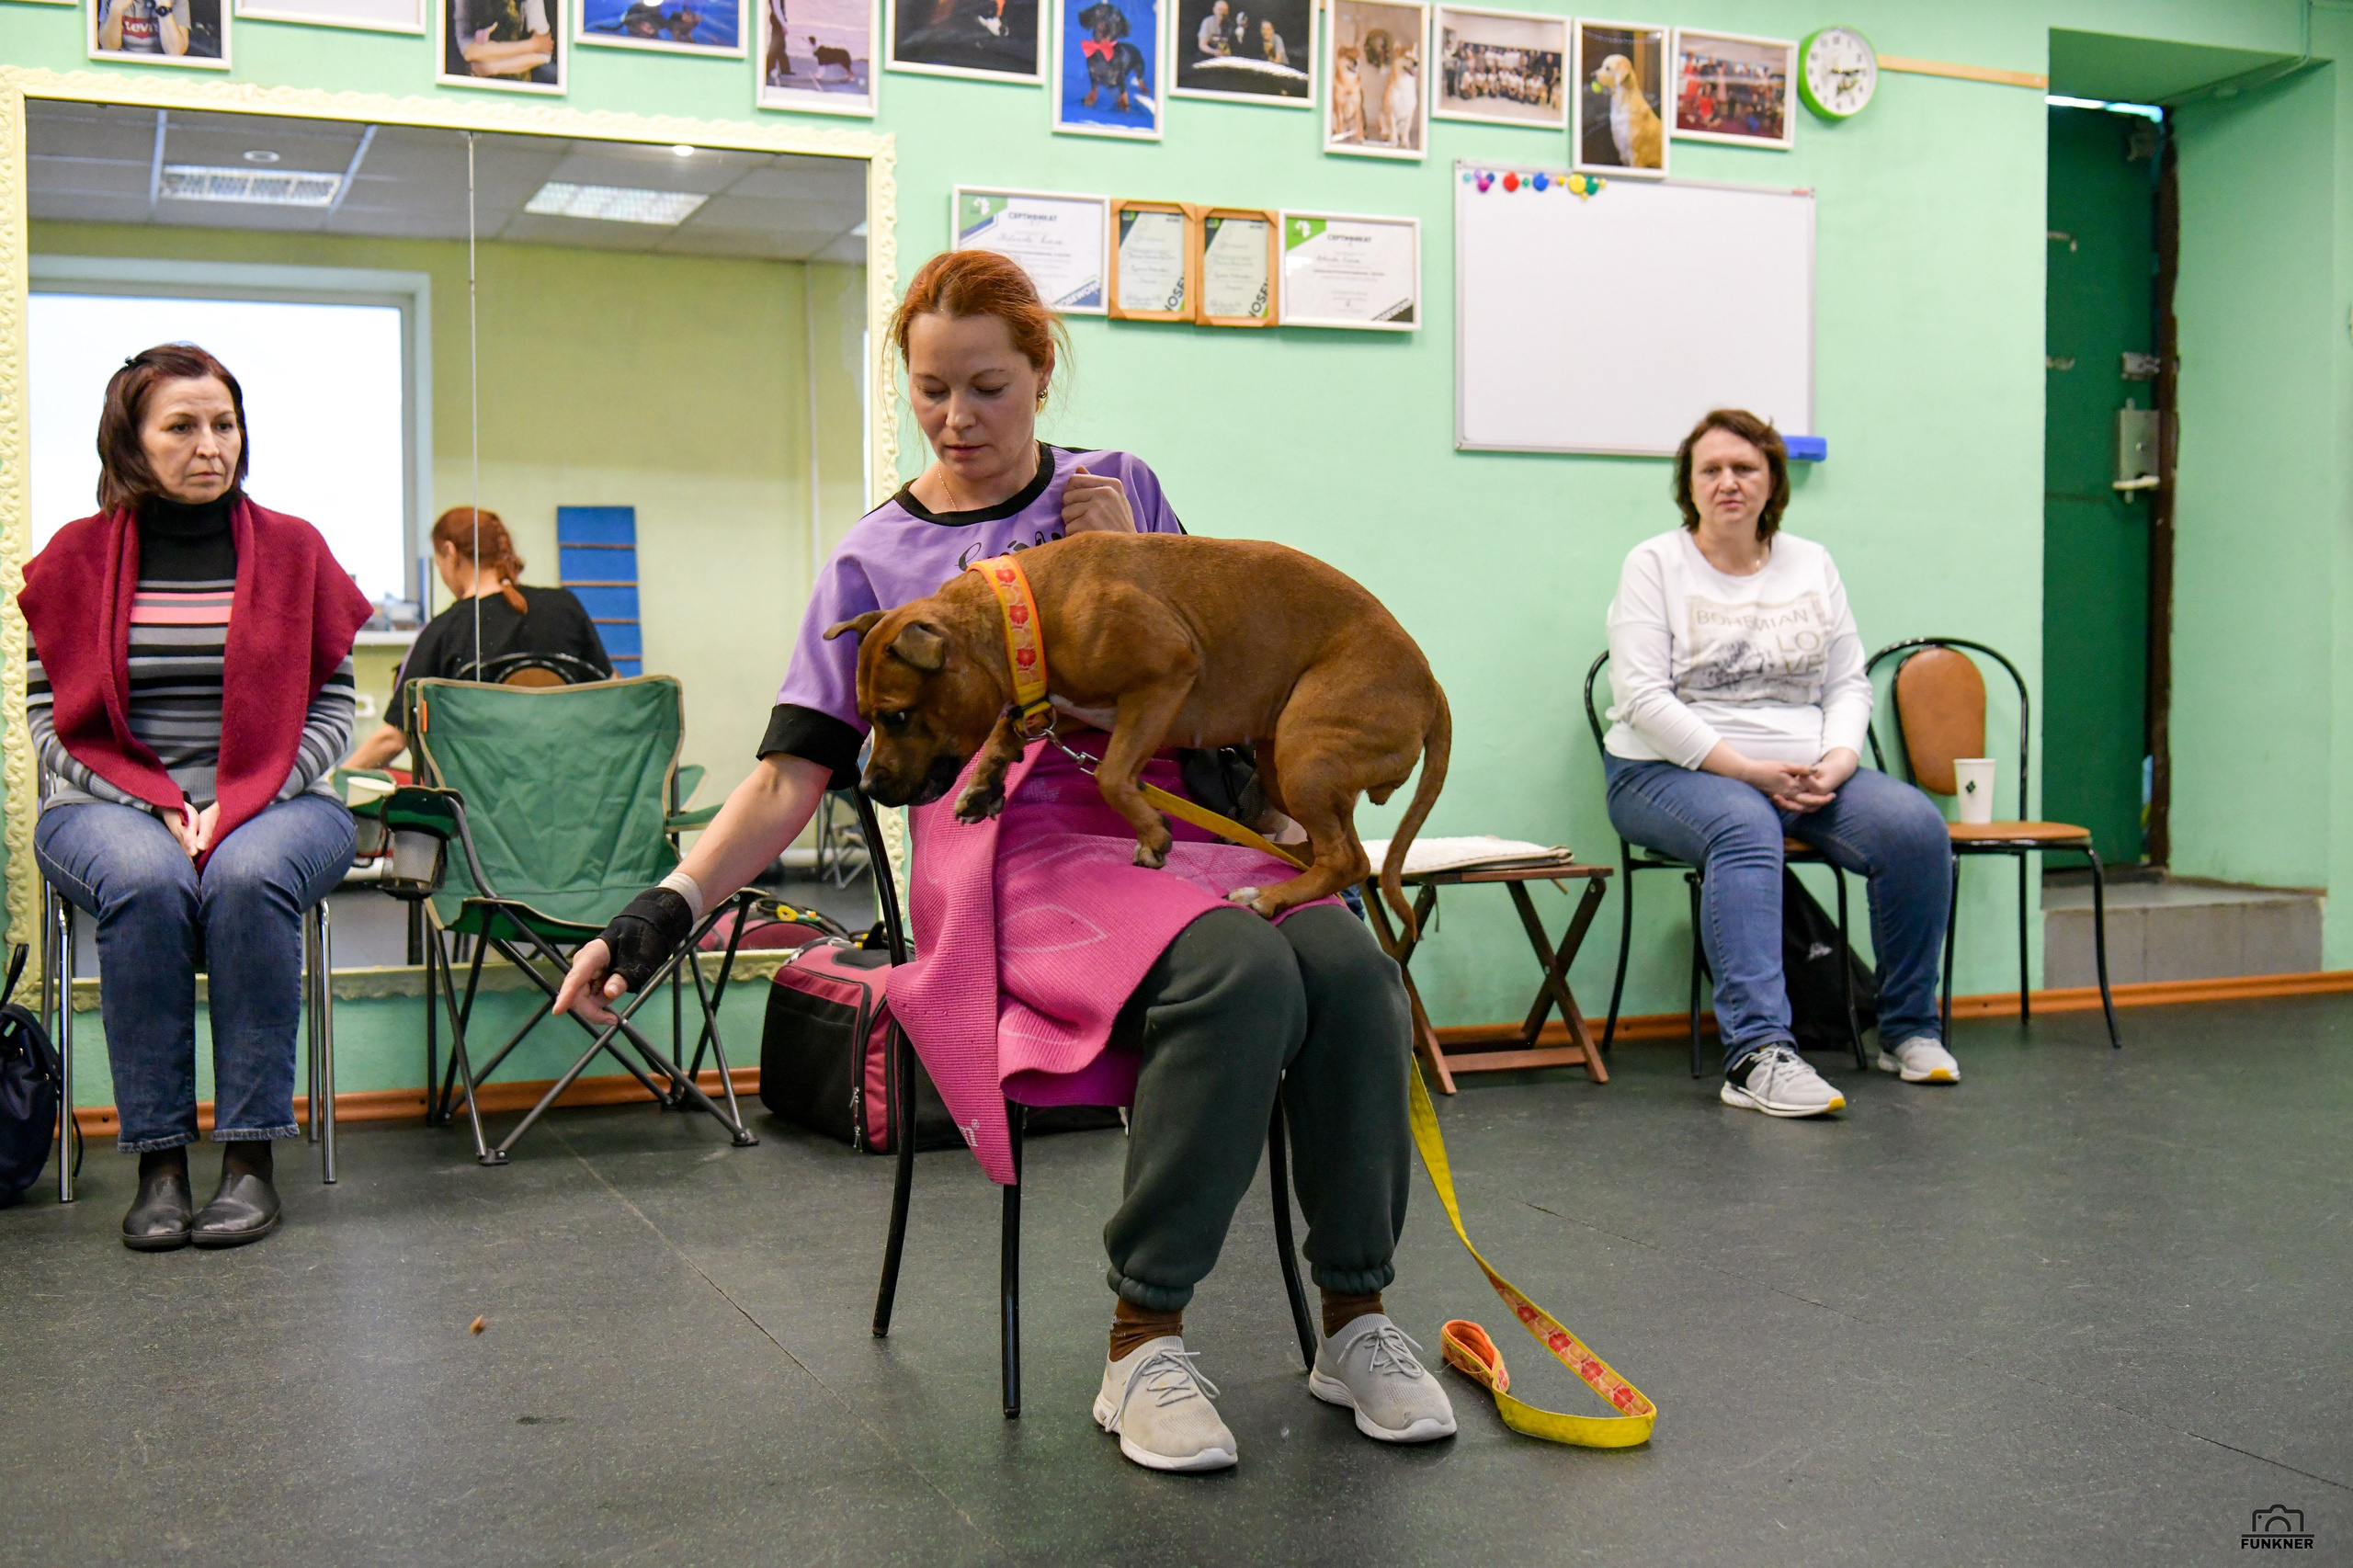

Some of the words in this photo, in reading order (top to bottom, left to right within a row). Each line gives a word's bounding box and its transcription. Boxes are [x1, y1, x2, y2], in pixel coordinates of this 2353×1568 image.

[1008, 212, 1058, 222] СЕРТИФИКАТ
[1327, 234, 1372, 244] СЕРТИФИКАТ
[1697, 608, 1809, 631] BOHEMIAN
